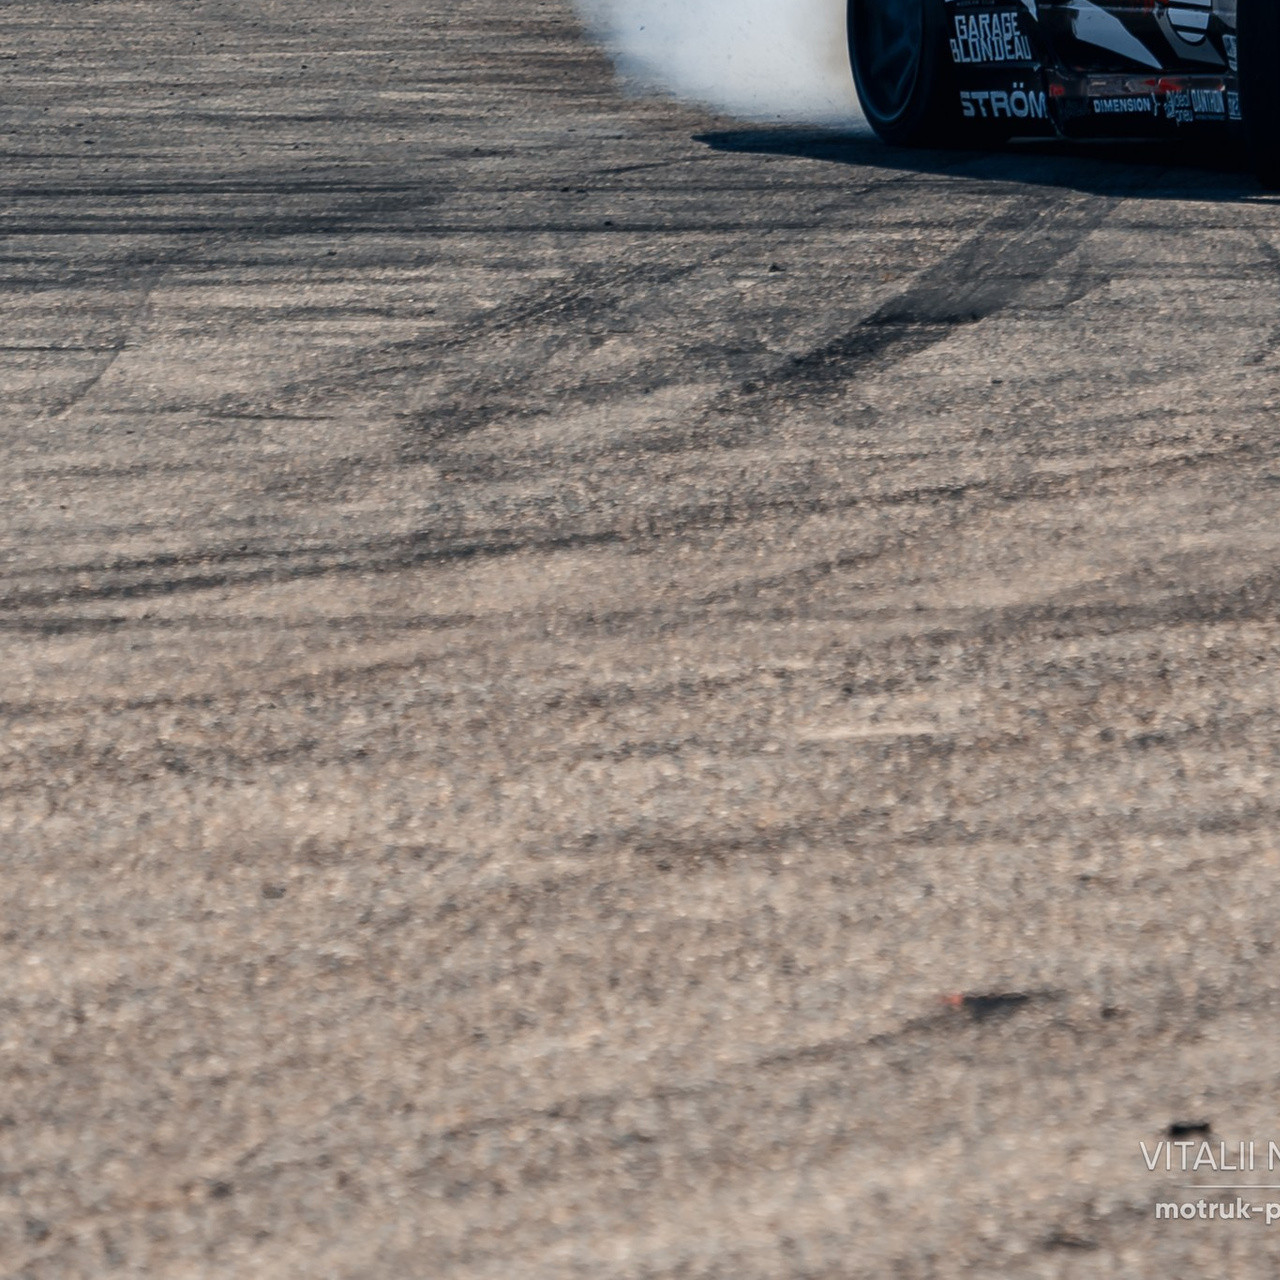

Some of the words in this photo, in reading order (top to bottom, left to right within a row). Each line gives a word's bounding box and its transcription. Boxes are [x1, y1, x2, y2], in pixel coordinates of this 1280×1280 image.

[954, 12, 1020, 40] GARAGE
[950, 35, 1032, 63] BLONDEAU
[960, 82, 1049, 119] STRÖM
[1093, 97, 1151, 113] DIMENSION
